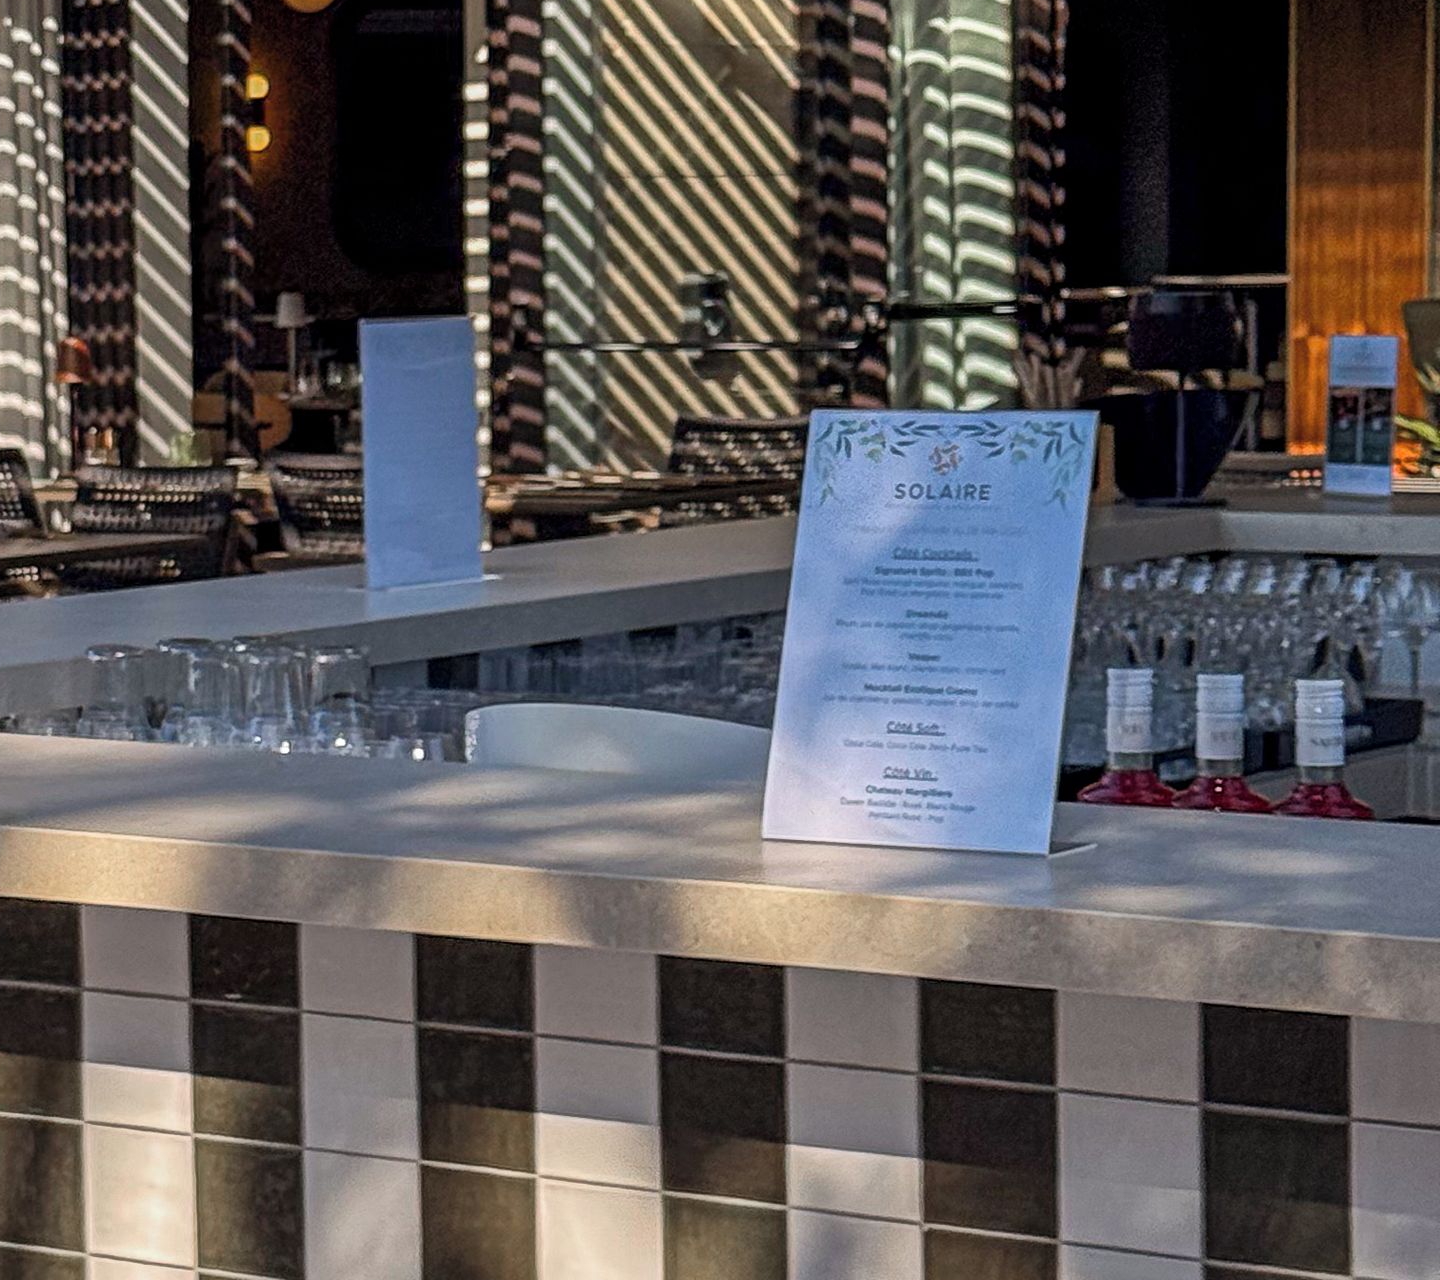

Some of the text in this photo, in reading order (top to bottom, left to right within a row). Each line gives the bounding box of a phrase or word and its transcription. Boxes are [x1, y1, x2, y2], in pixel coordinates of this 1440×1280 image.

[893, 482, 992, 501] SOLAIRE
[886, 721, 913, 732] Côté
[916, 723, 940, 733] Soft
[883, 766, 910, 777] Côté
[913, 767, 933, 778] Vin
